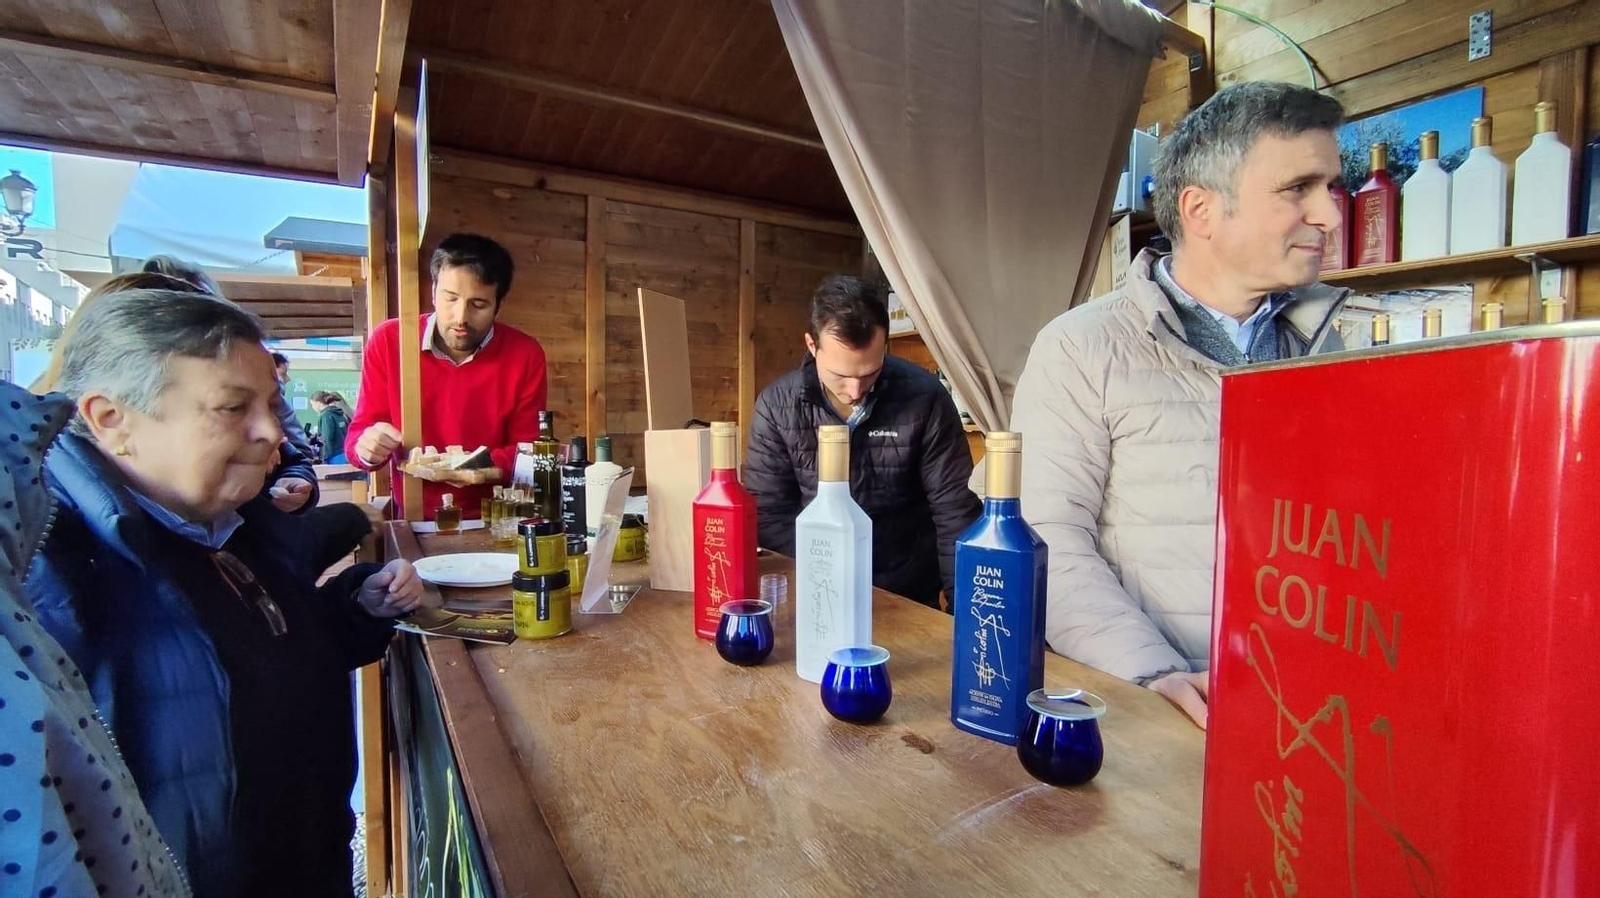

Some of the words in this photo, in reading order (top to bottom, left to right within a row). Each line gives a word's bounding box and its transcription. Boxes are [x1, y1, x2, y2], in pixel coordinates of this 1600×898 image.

[707, 517, 724, 526] JUAN
[705, 525, 725, 533] COLIN
[811, 539, 831, 548] JUAN
[1266, 498, 1392, 579] JUAN
[810, 547, 832, 557] COLIN
[976, 565, 1002, 577] JUAN
[973, 576, 1004, 589] COLIN
[1254, 564, 1402, 672] COLIN
